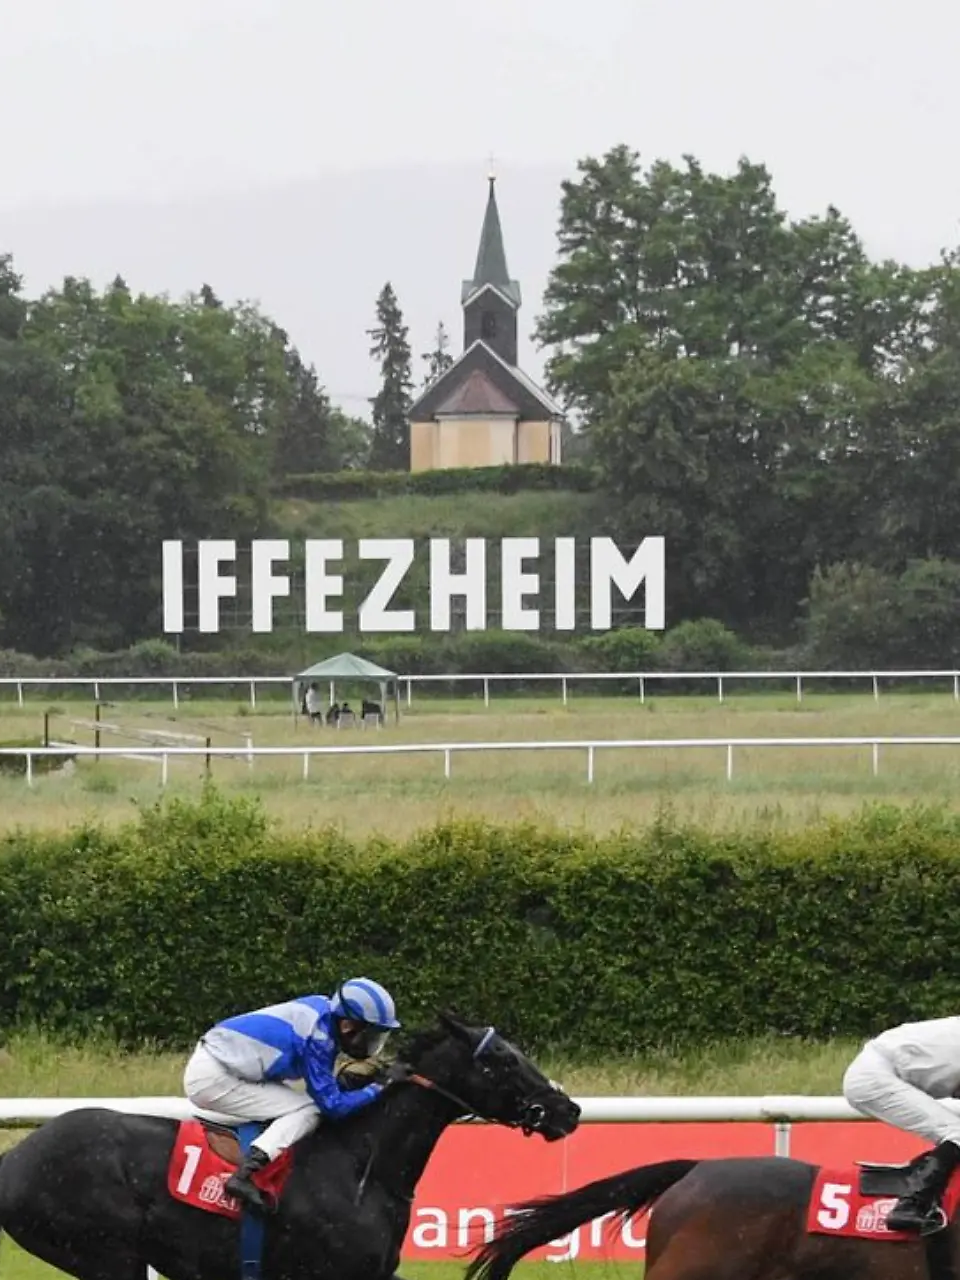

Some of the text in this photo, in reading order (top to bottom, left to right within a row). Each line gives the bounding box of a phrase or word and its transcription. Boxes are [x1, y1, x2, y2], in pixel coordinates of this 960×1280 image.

[162, 536, 665, 633] IFFEZHEIM
[176, 1145, 203, 1195] 1
[817, 1184, 851, 1230] 5
